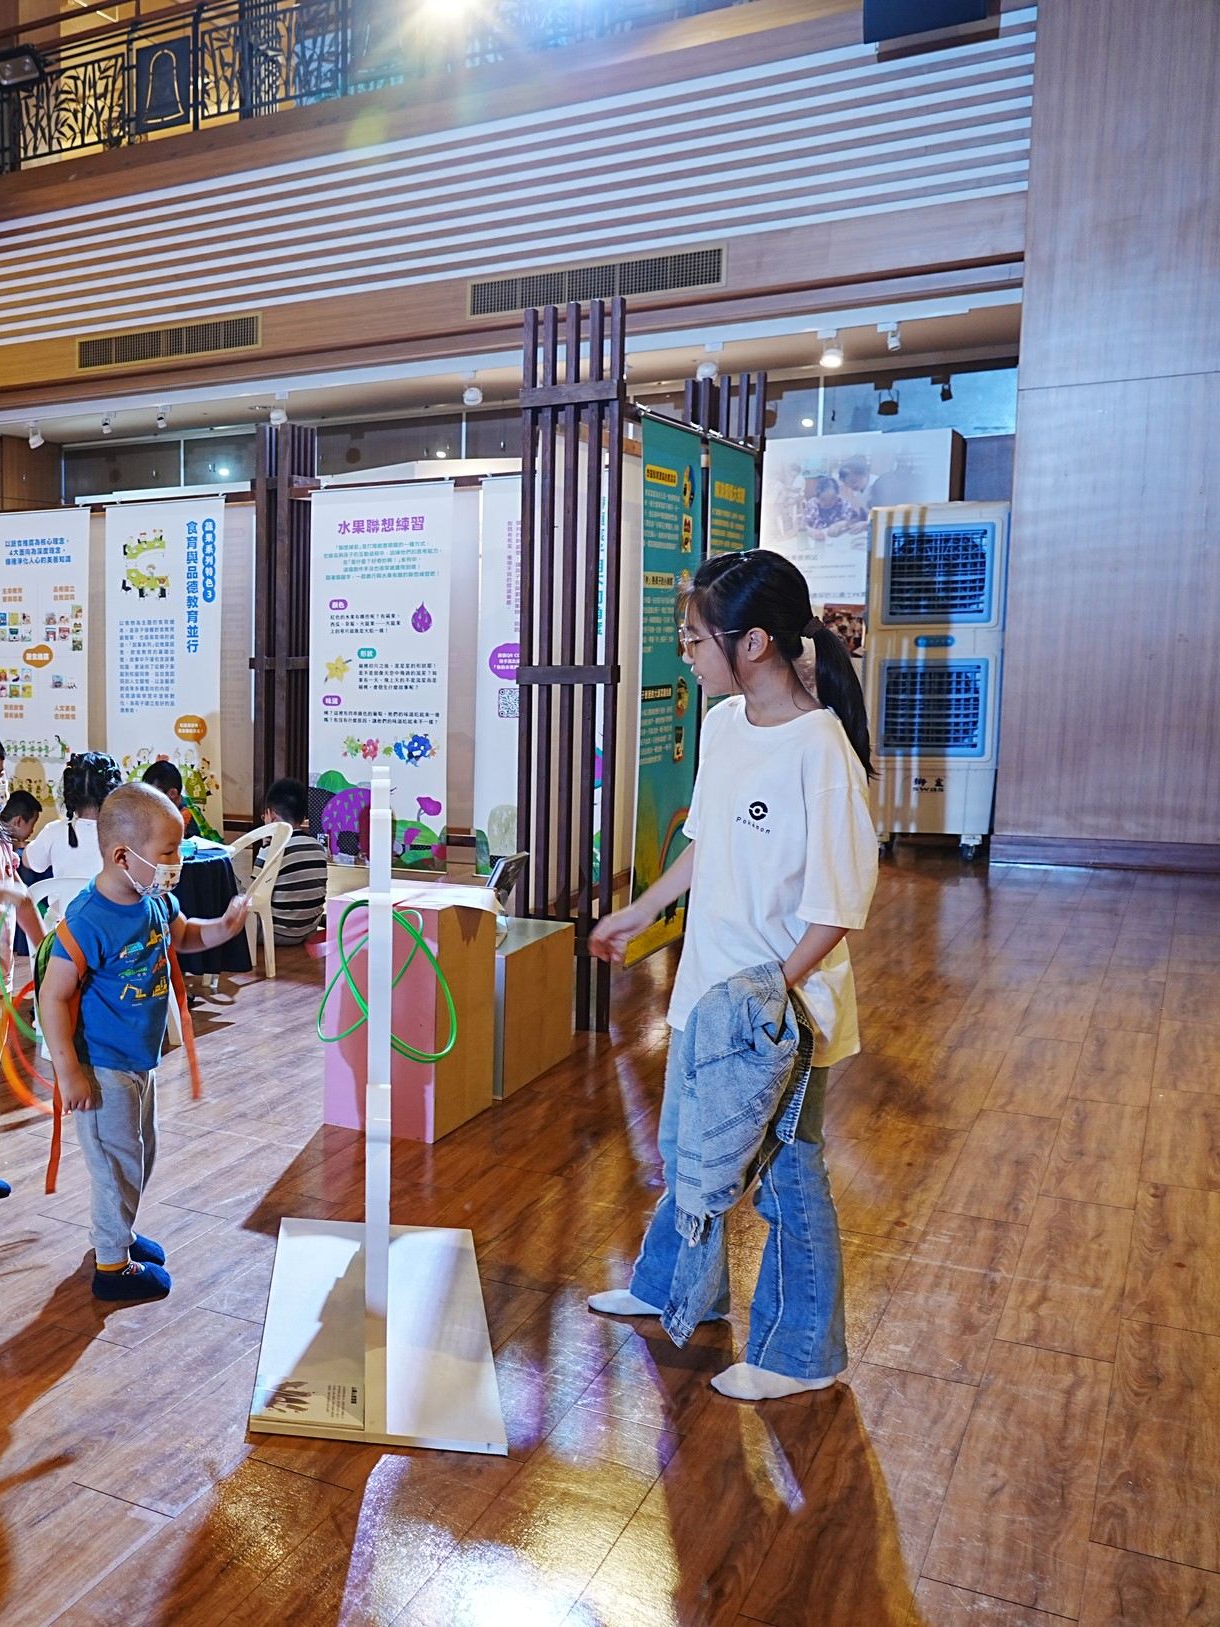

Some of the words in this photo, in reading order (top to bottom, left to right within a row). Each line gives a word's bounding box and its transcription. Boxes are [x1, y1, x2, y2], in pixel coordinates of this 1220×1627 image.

[337, 515, 425, 535] 水果聯想練習
[186, 520, 199, 653] 食育與品德教育並行
